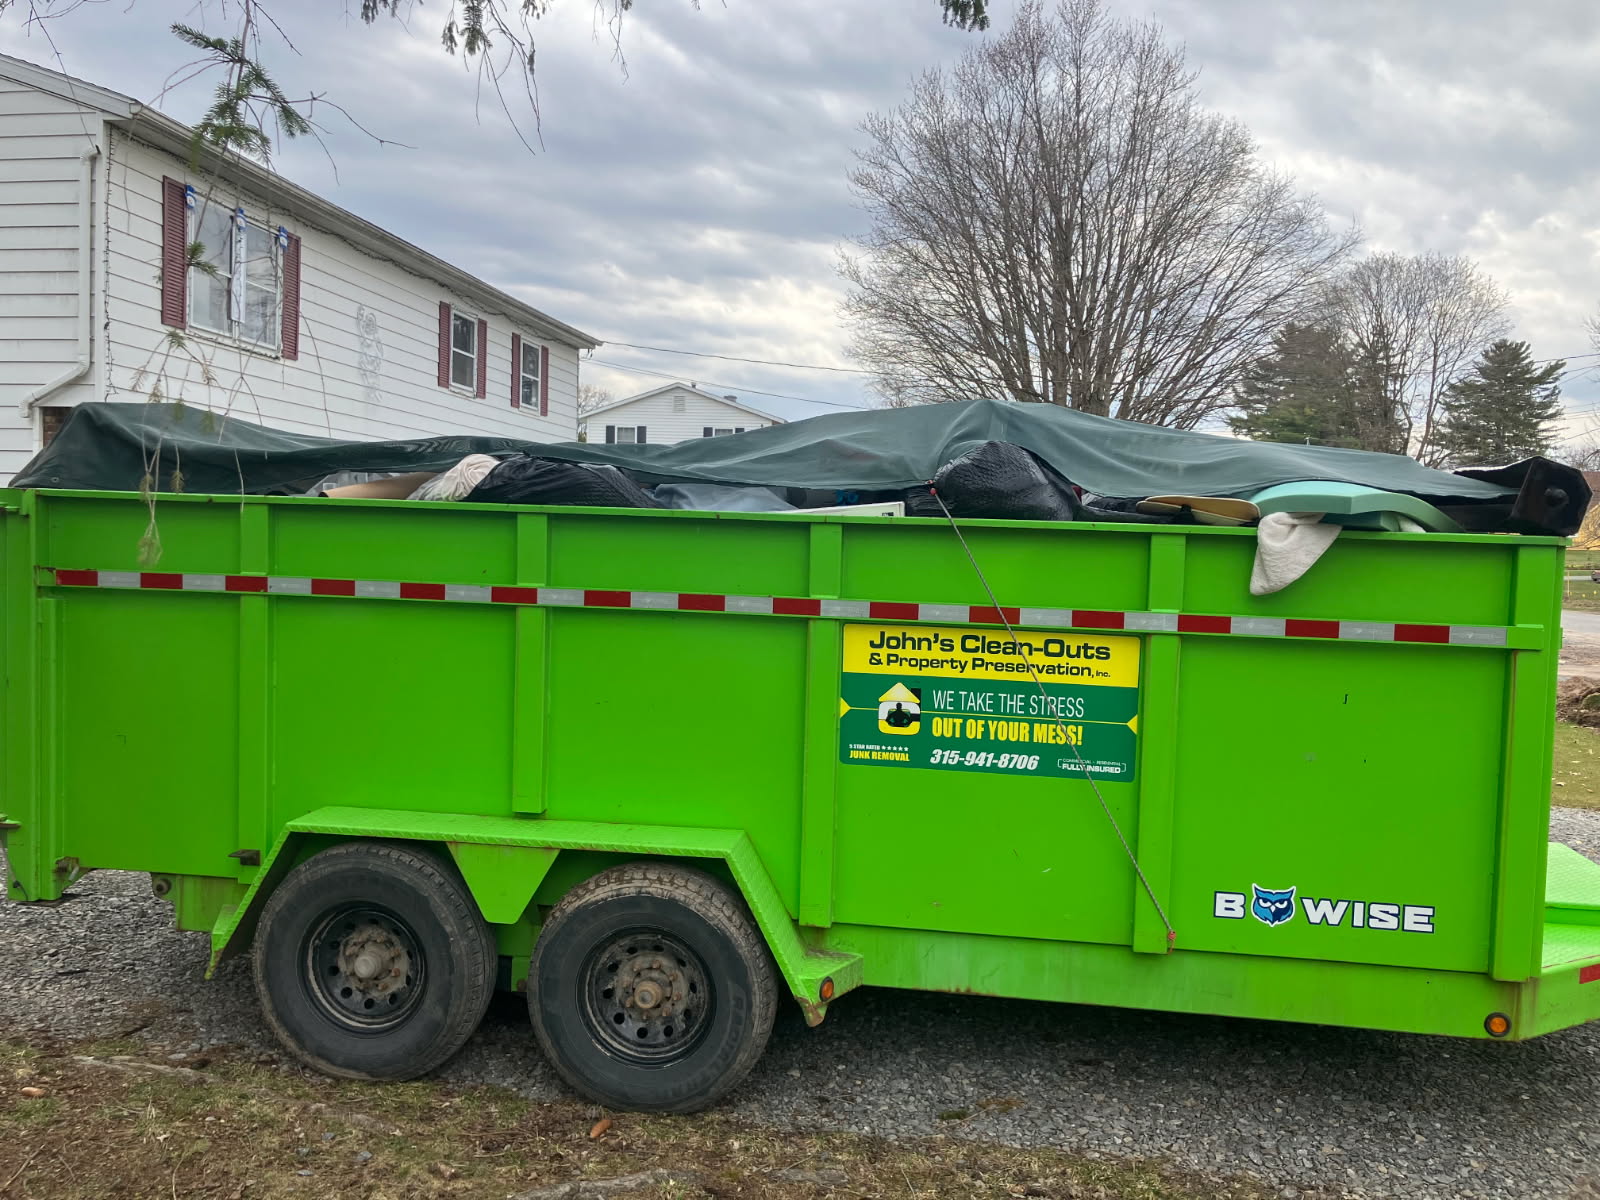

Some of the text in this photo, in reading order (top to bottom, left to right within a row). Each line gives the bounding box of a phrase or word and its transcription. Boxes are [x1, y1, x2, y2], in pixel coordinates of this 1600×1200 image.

[869, 631, 1111, 661] John's Clean-Outs
[868, 652, 883, 666] &
[886, 654, 968, 673] Property
[971, 657, 1094, 679] Preservation,
[932, 689, 1085, 718] WE TAKE THE STRESS
[931, 717, 1083, 746] OUT OF YOUR MESS!
[849, 750, 910, 761] JUNK REMOVAL
[930, 748, 1040, 771] 315-941-8706
[1062, 763, 1121, 773] FULLY INSURED
